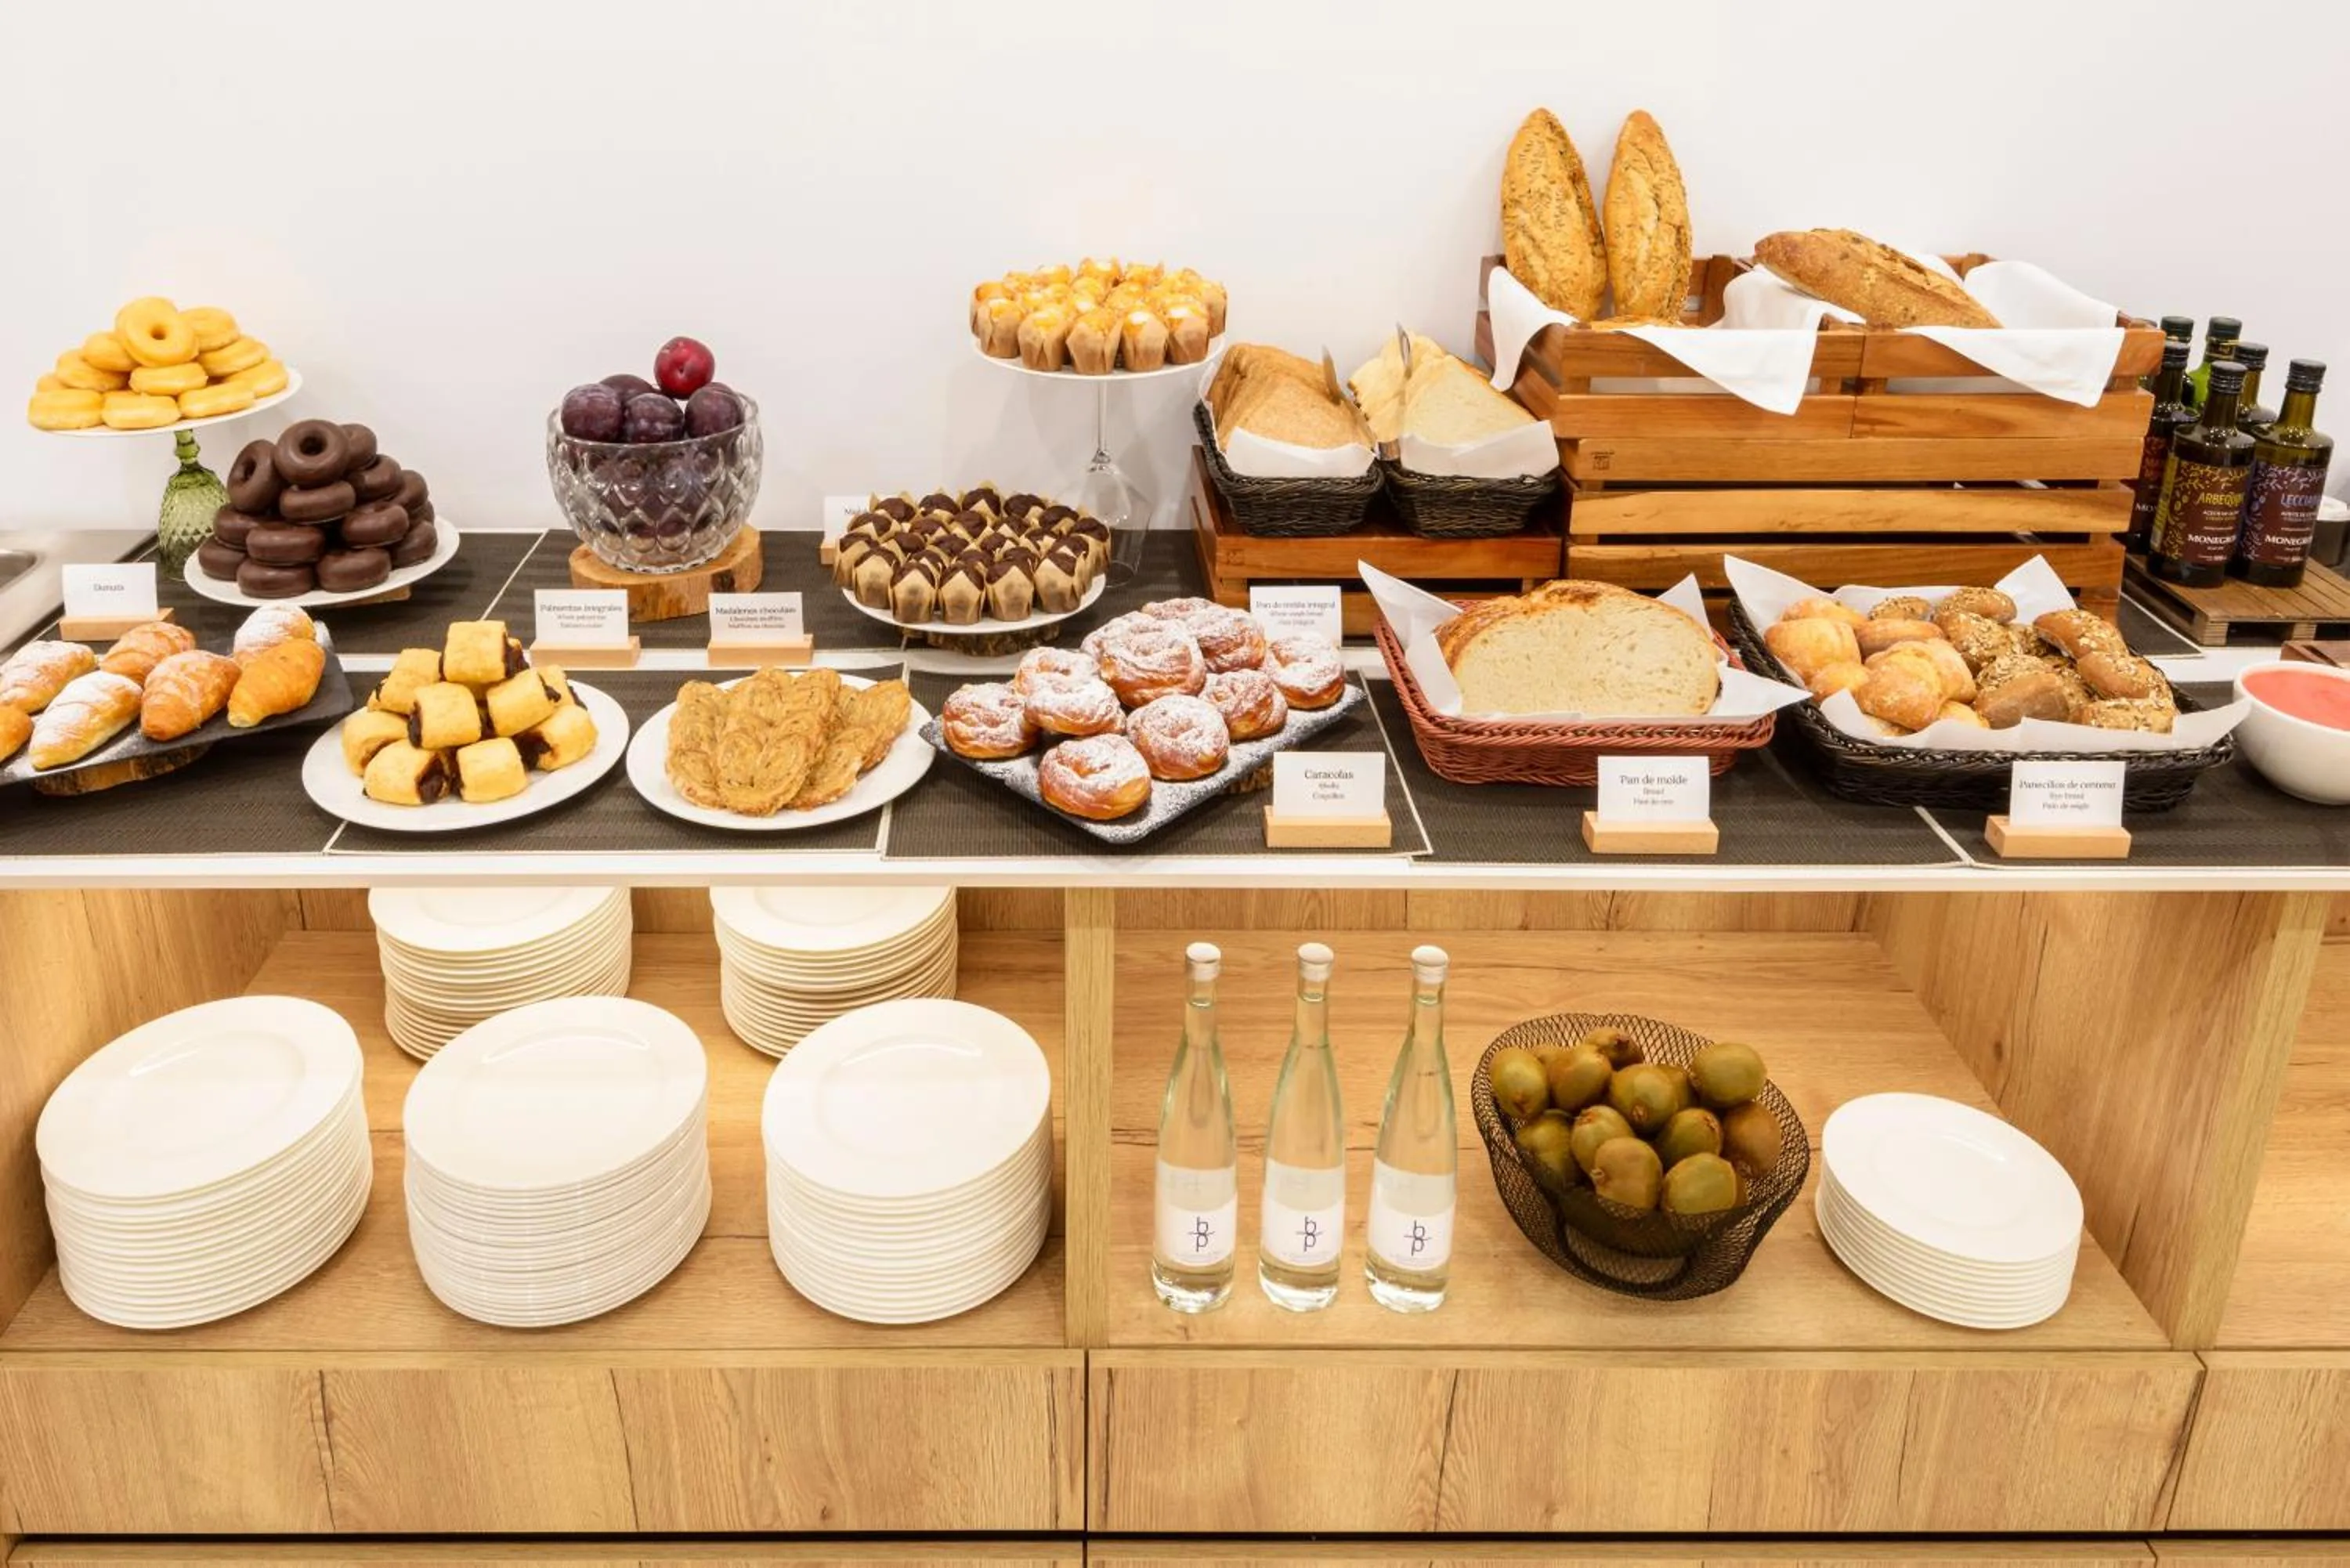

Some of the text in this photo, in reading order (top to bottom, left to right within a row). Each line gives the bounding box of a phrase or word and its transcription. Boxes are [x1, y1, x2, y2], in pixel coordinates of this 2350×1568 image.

[1304, 770, 1354, 779] Caracolas
[1620, 775, 1687, 785] Pan de molde
